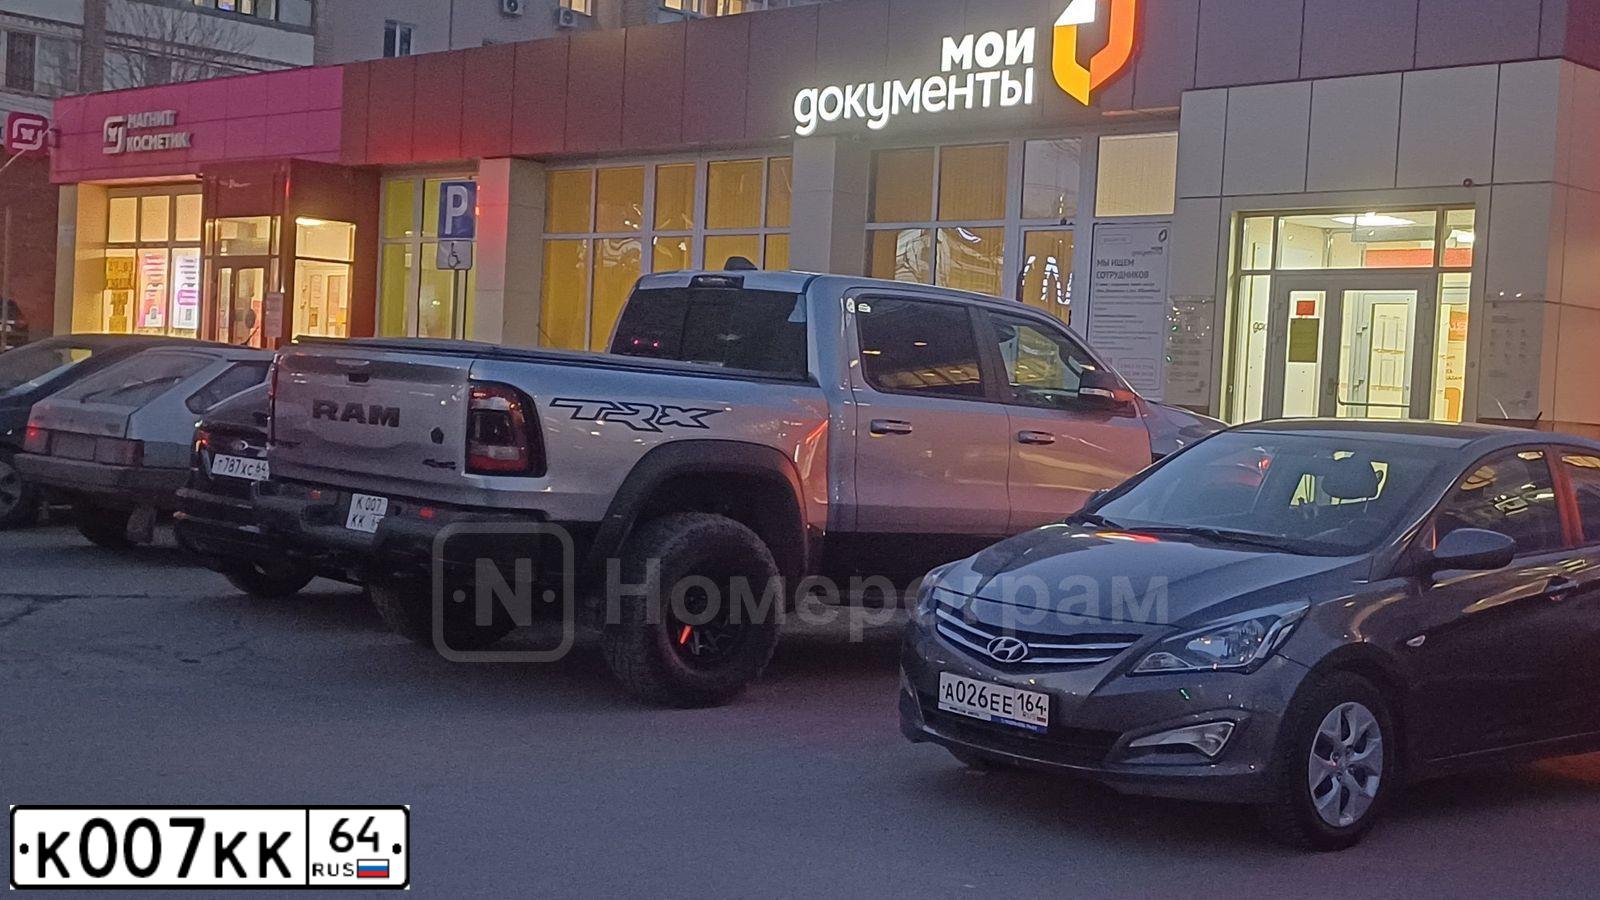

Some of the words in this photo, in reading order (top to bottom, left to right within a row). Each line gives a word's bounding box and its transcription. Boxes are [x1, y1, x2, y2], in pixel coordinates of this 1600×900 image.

[794, 67, 1034, 136] документы
[127, 109, 176, 128] МАГНИТ
[126, 132, 191, 152] КОСМЕТИК
[1096, 258, 1110, 267] МЫ
[1111, 258, 1134, 267] ИЩЕМ
[1096, 270, 1149, 279] СОТРУДНИКОВ
[313, 400, 400, 427] RAM
[550, 398, 722, 432] TRX
[1017, 693, 1044, 715] 164
